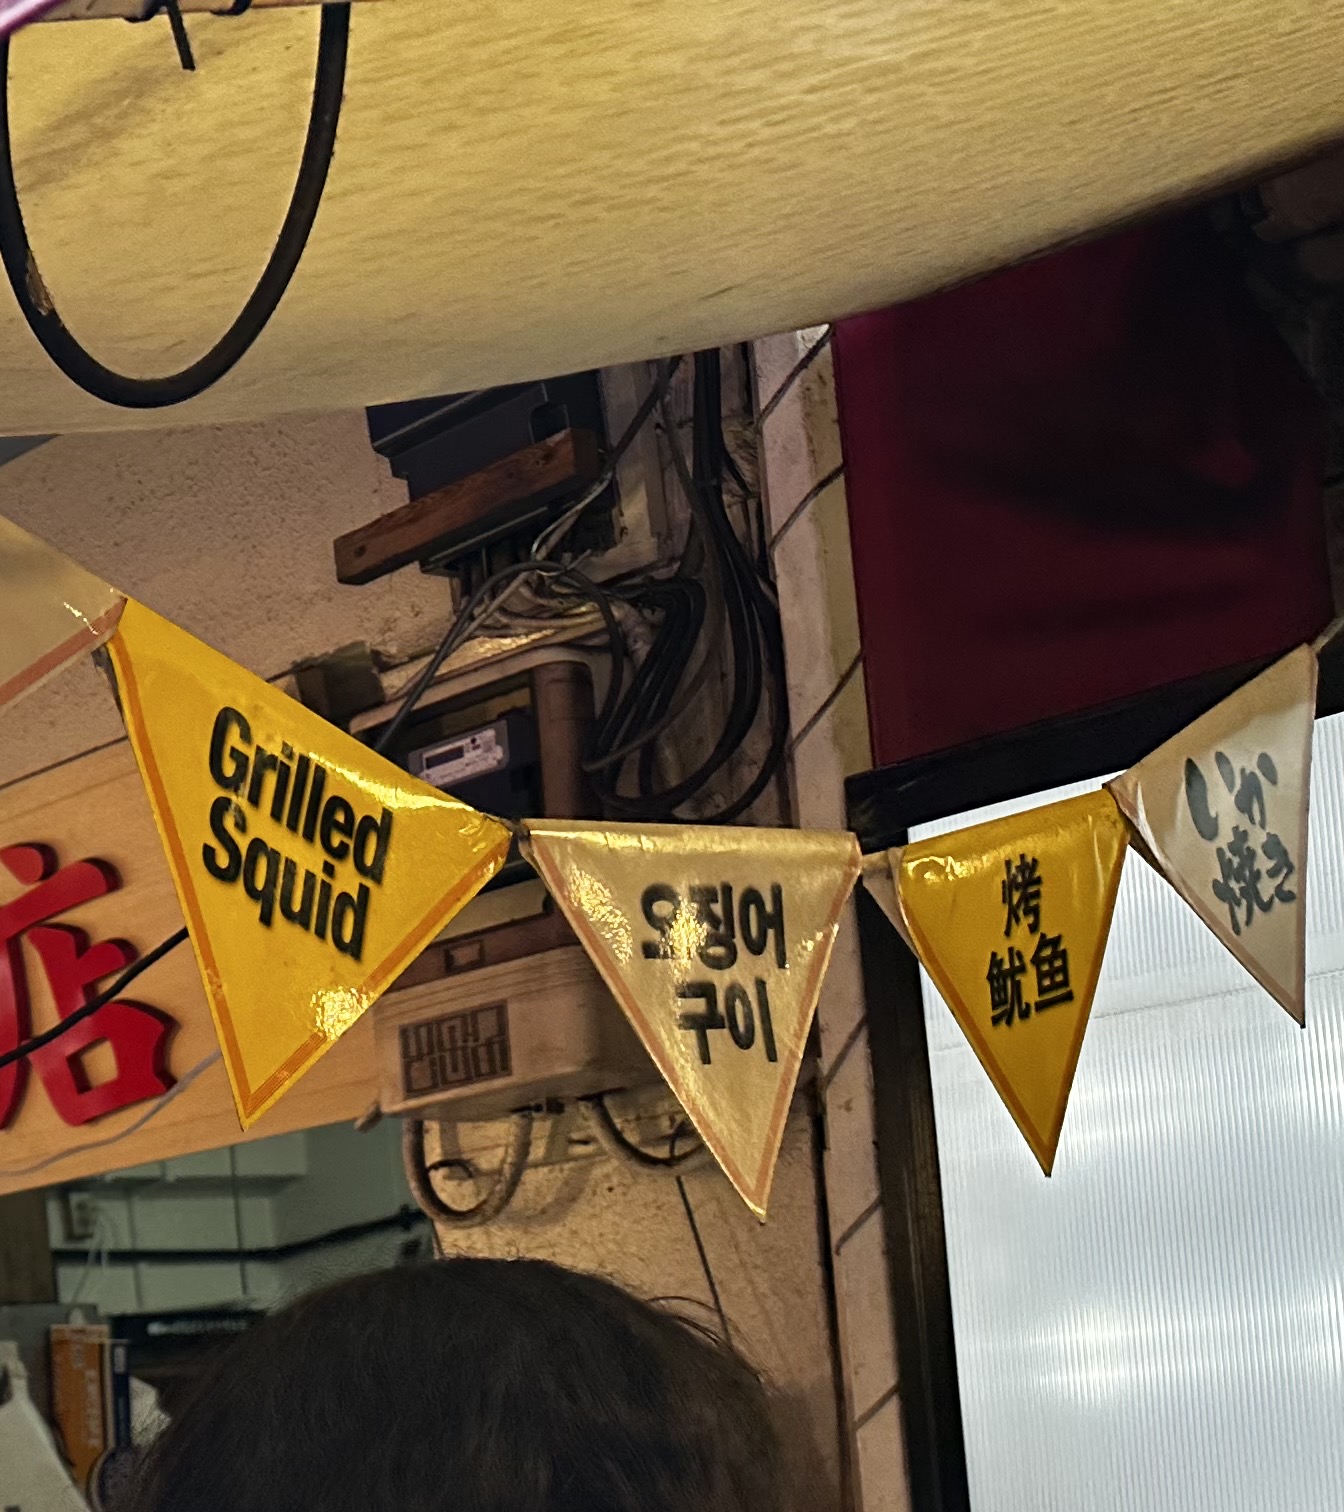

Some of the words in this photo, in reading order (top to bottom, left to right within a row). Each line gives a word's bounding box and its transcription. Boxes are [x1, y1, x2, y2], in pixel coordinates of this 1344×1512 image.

[208, 706, 394, 887] Grilled
[1184, 751, 1279, 841] いか
[201, 795, 371, 963] Squid
[640, 880, 787, 971] 오징어
[1001, 852, 1043, 938] 烤
[1212, 825, 1297, 936] 焼き
[674, 976, 779, 1065] 구이
[985, 932, 1075, 1027] 鱿鱼
